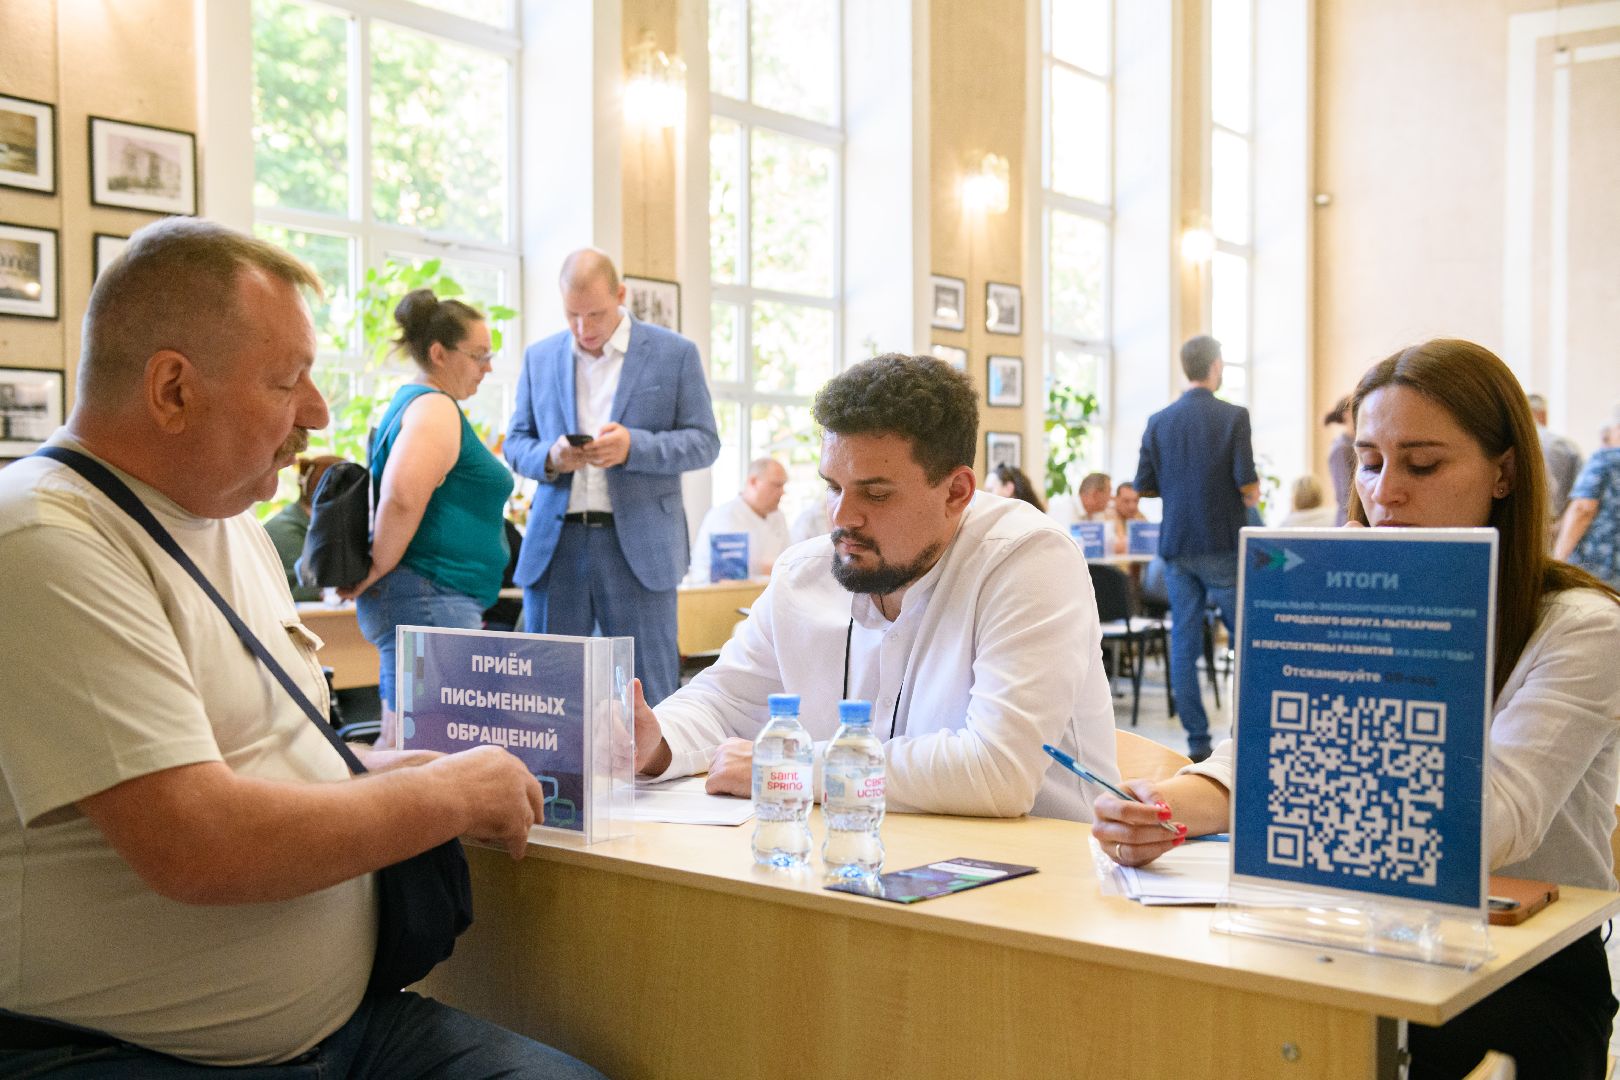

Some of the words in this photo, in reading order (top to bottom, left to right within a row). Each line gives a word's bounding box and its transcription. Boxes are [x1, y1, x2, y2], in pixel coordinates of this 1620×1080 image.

[1326, 570, 1399, 590] ИТОГИ
[472, 652, 532, 676] ПРИЁМ
[1282, 664, 1382, 683] Отсканируйте
[440, 686, 566, 716] ПИСЬМЕННЫХ
[446, 721, 558, 751] ОБРАЩЕНИЙ
